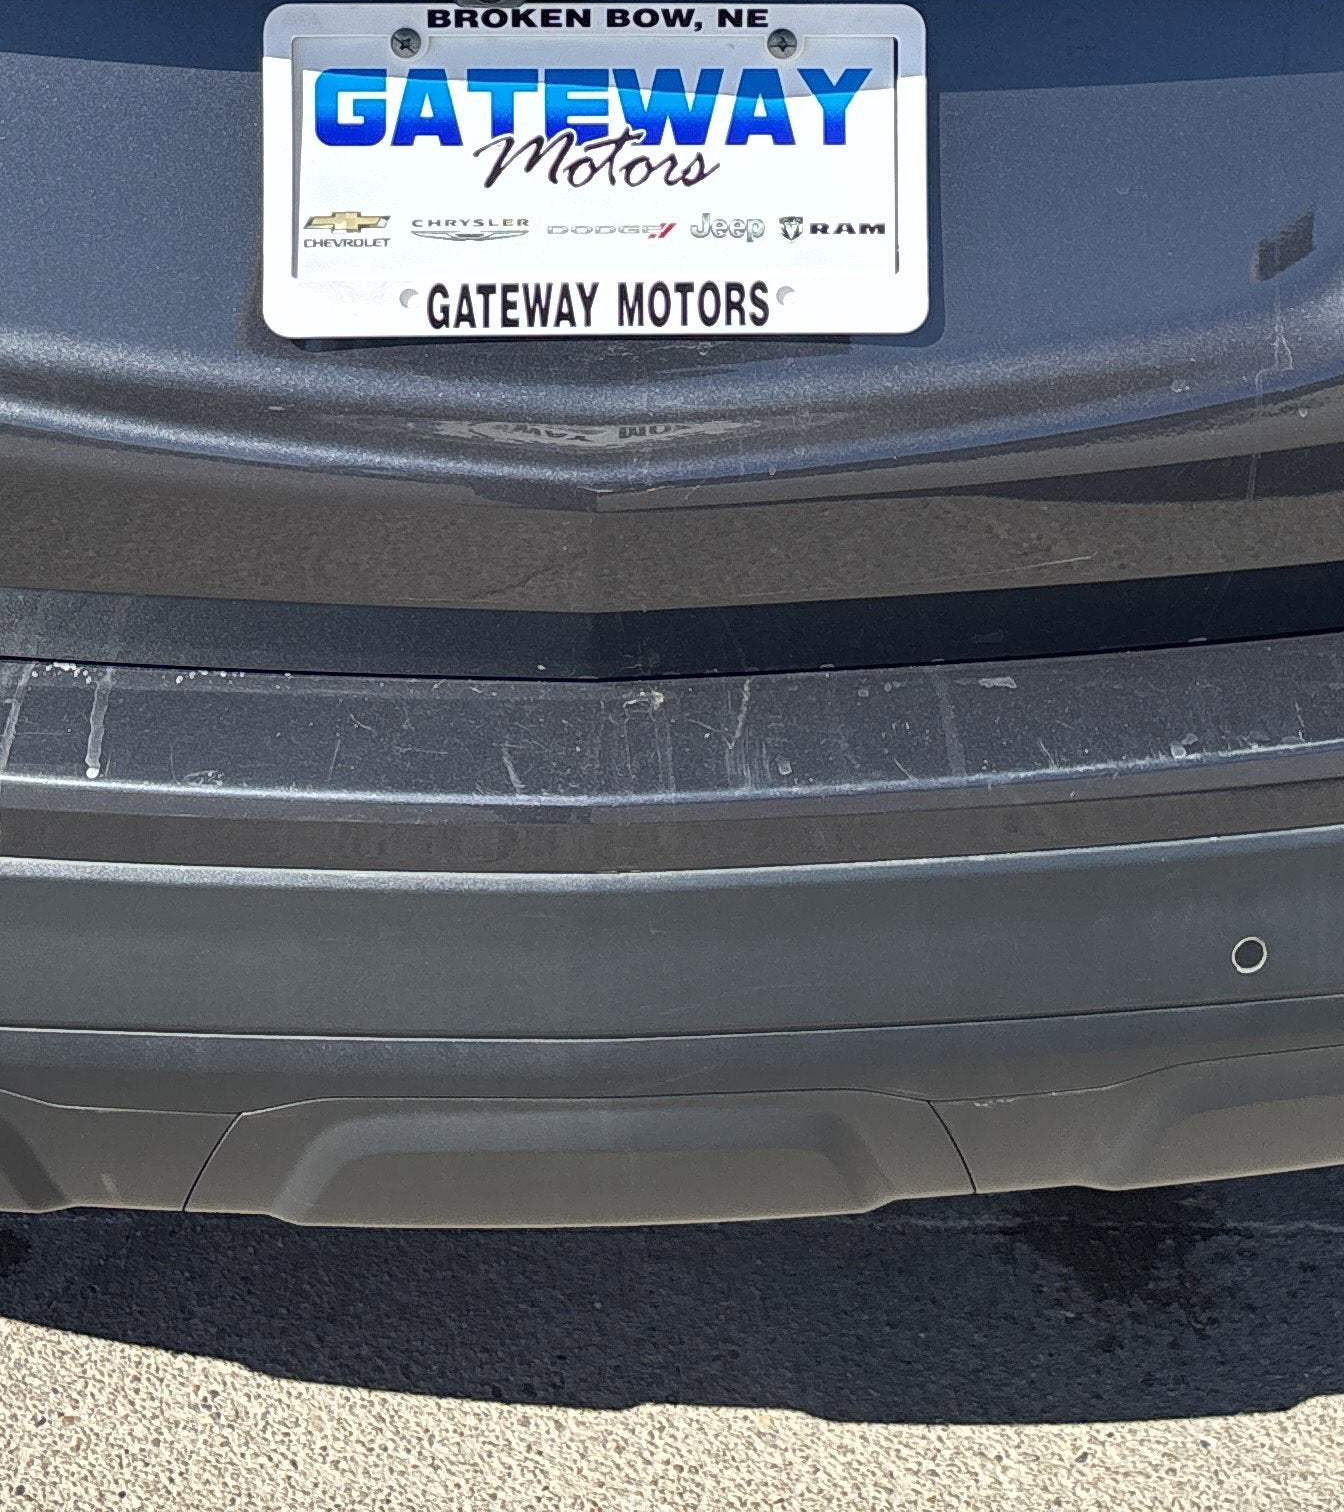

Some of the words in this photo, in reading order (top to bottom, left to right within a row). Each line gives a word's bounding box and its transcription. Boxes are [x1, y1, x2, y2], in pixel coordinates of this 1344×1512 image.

[427, 8, 591, 28] BROKEN
[606, 8, 703, 31] BOW,
[717, 8, 769, 28] NE
[314, 68, 873, 147] GATEWAY
[473, 127, 721, 189] Motors
[411, 218, 529, 228] CHRYSLER
[547, 225, 660, 236] DODGE
[689, 213, 766, 243] Jeep
[809, 222, 886, 235] RAM
[303, 238, 391, 248] CHEVROLET
[427, 282, 599, 328] GATEWAY
[617, 281, 770, 327] MOTORS
